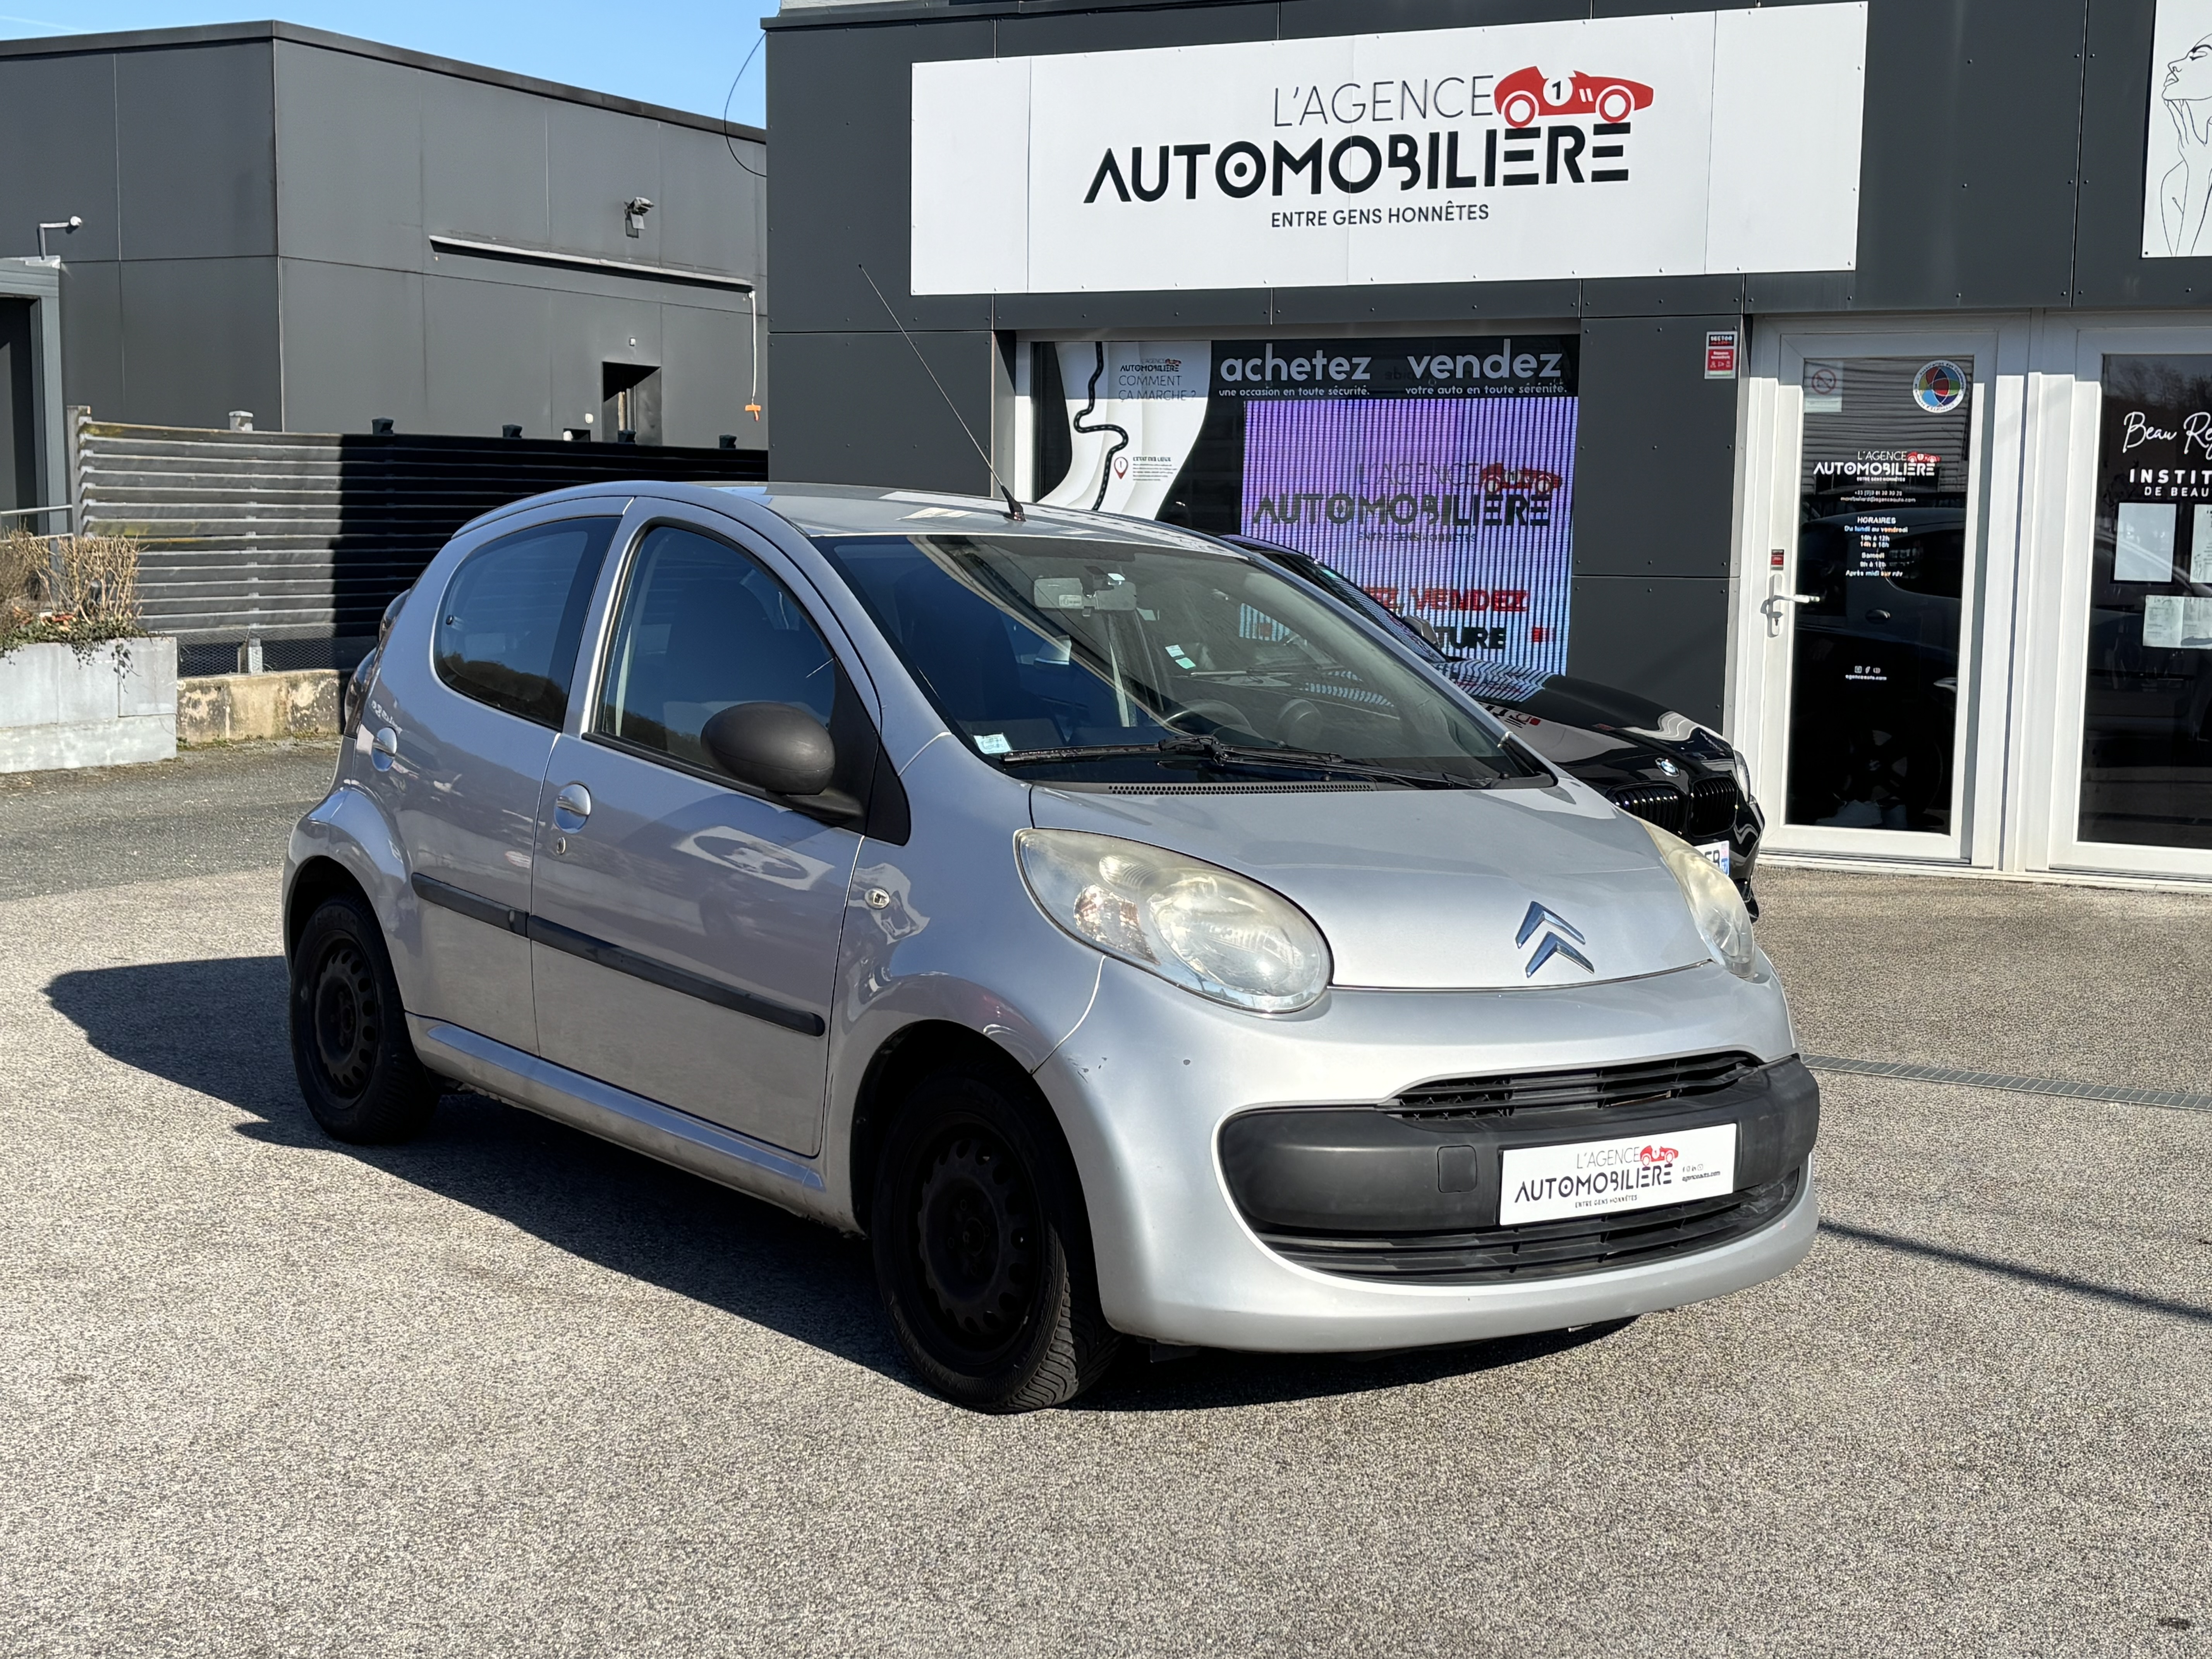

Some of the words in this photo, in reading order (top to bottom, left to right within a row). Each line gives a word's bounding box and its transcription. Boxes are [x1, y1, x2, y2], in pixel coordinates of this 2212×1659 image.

[1551, 81, 1562, 100] 1
[1274, 74, 1494, 127] L'AGENCE
[1271, 210, 1327, 228] ENTRE
[1333, 208, 1382, 225] GENS
[1388, 201, 1489, 223] HONNÊTES
[1220, 343, 1372, 382] achetez
[1407, 338, 1563, 379] vendez
[1118, 375, 1182, 386] COMMENT
[1405, 386, 1434, 395] votre
[1437, 386, 1463, 394] auto
[1484, 385, 1515, 394] toute
[1518, 382, 1567, 394] sérénité.
[1118, 390, 1134, 402] ÇA
[1137, 390, 1187, 401] MARCHE
[1240, 387, 1280, 396] occasion
[1298, 387, 1324, 396] toute
[1328, 385, 1370, 396] sécurité.
[2122, 411, 2178, 453] Beau
[1858, 451, 1908, 461] L'AGENCE
[2130, 469, 2212, 484] INSTIT
[2144, 486, 2162, 496] DE
[2171, 487, 2209, 497] BEAU
[1411, 587, 1528, 612] VENDEZ
[1577, 1146, 1640, 1170] L'AGENCE
